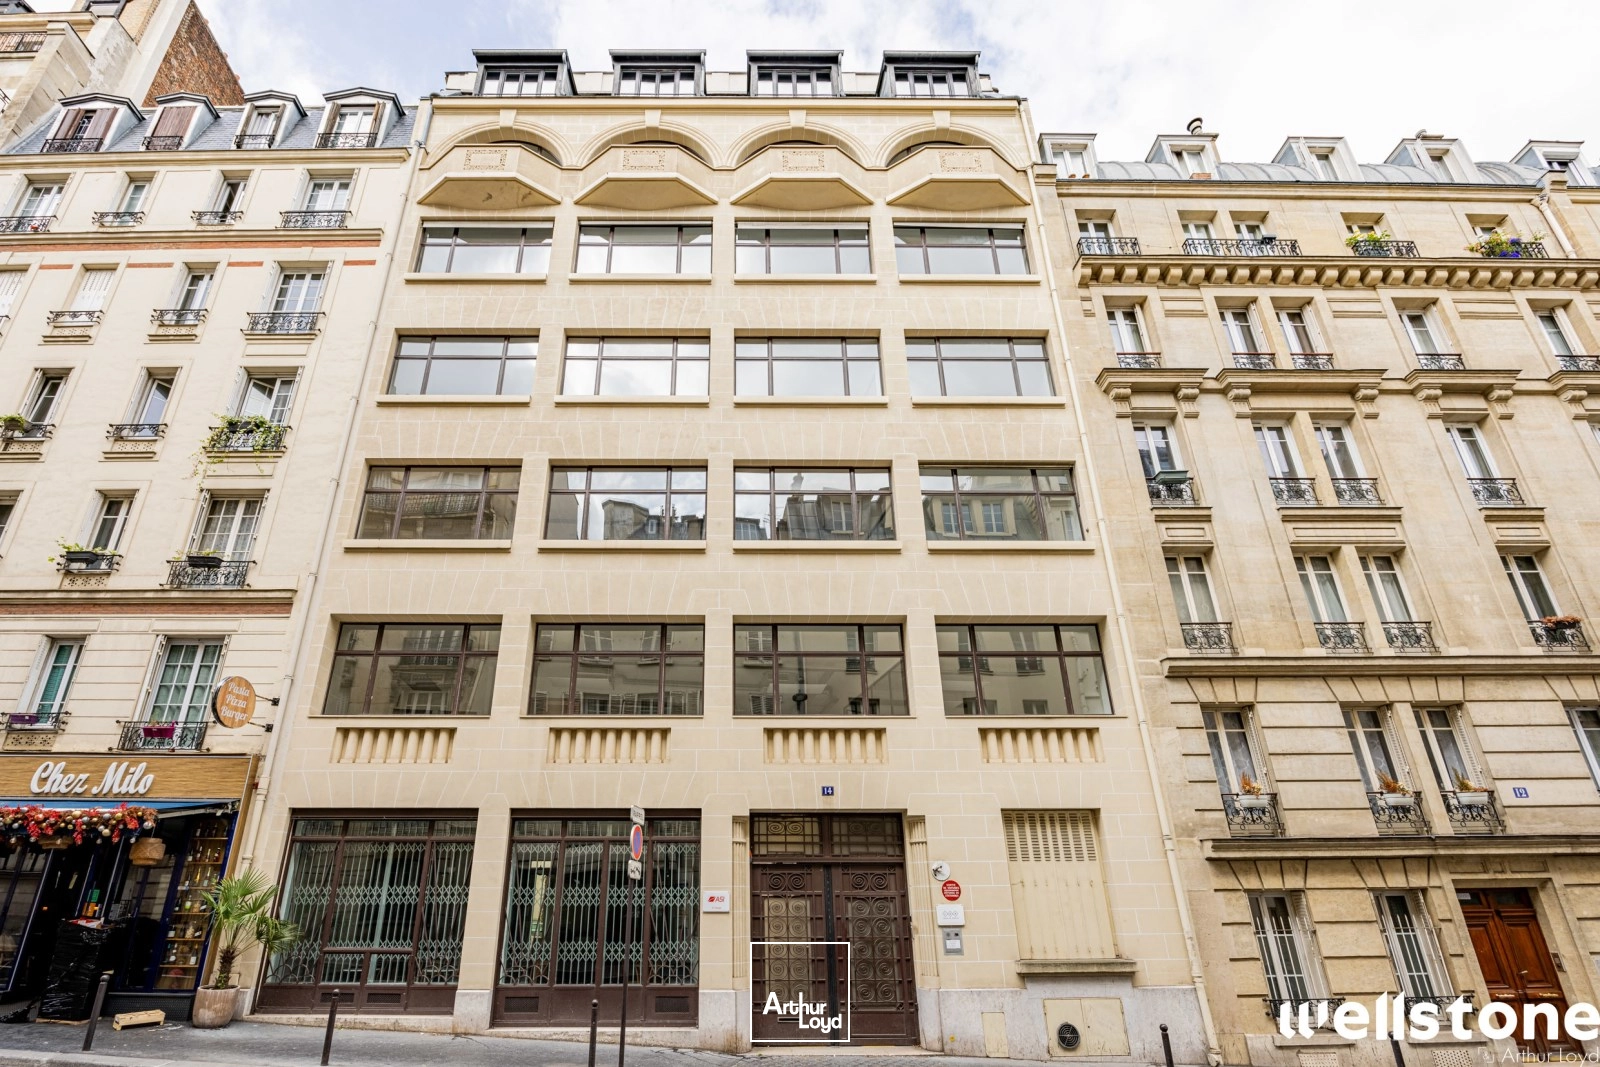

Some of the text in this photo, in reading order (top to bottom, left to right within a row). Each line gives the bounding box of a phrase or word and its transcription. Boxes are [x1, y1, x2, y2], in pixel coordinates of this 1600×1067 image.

[226, 694, 247, 708] Pizza
[221, 706, 248, 721] Burger
[30, 761, 154, 795] Chez Milo
[1515, 788, 1527, 798] 12
